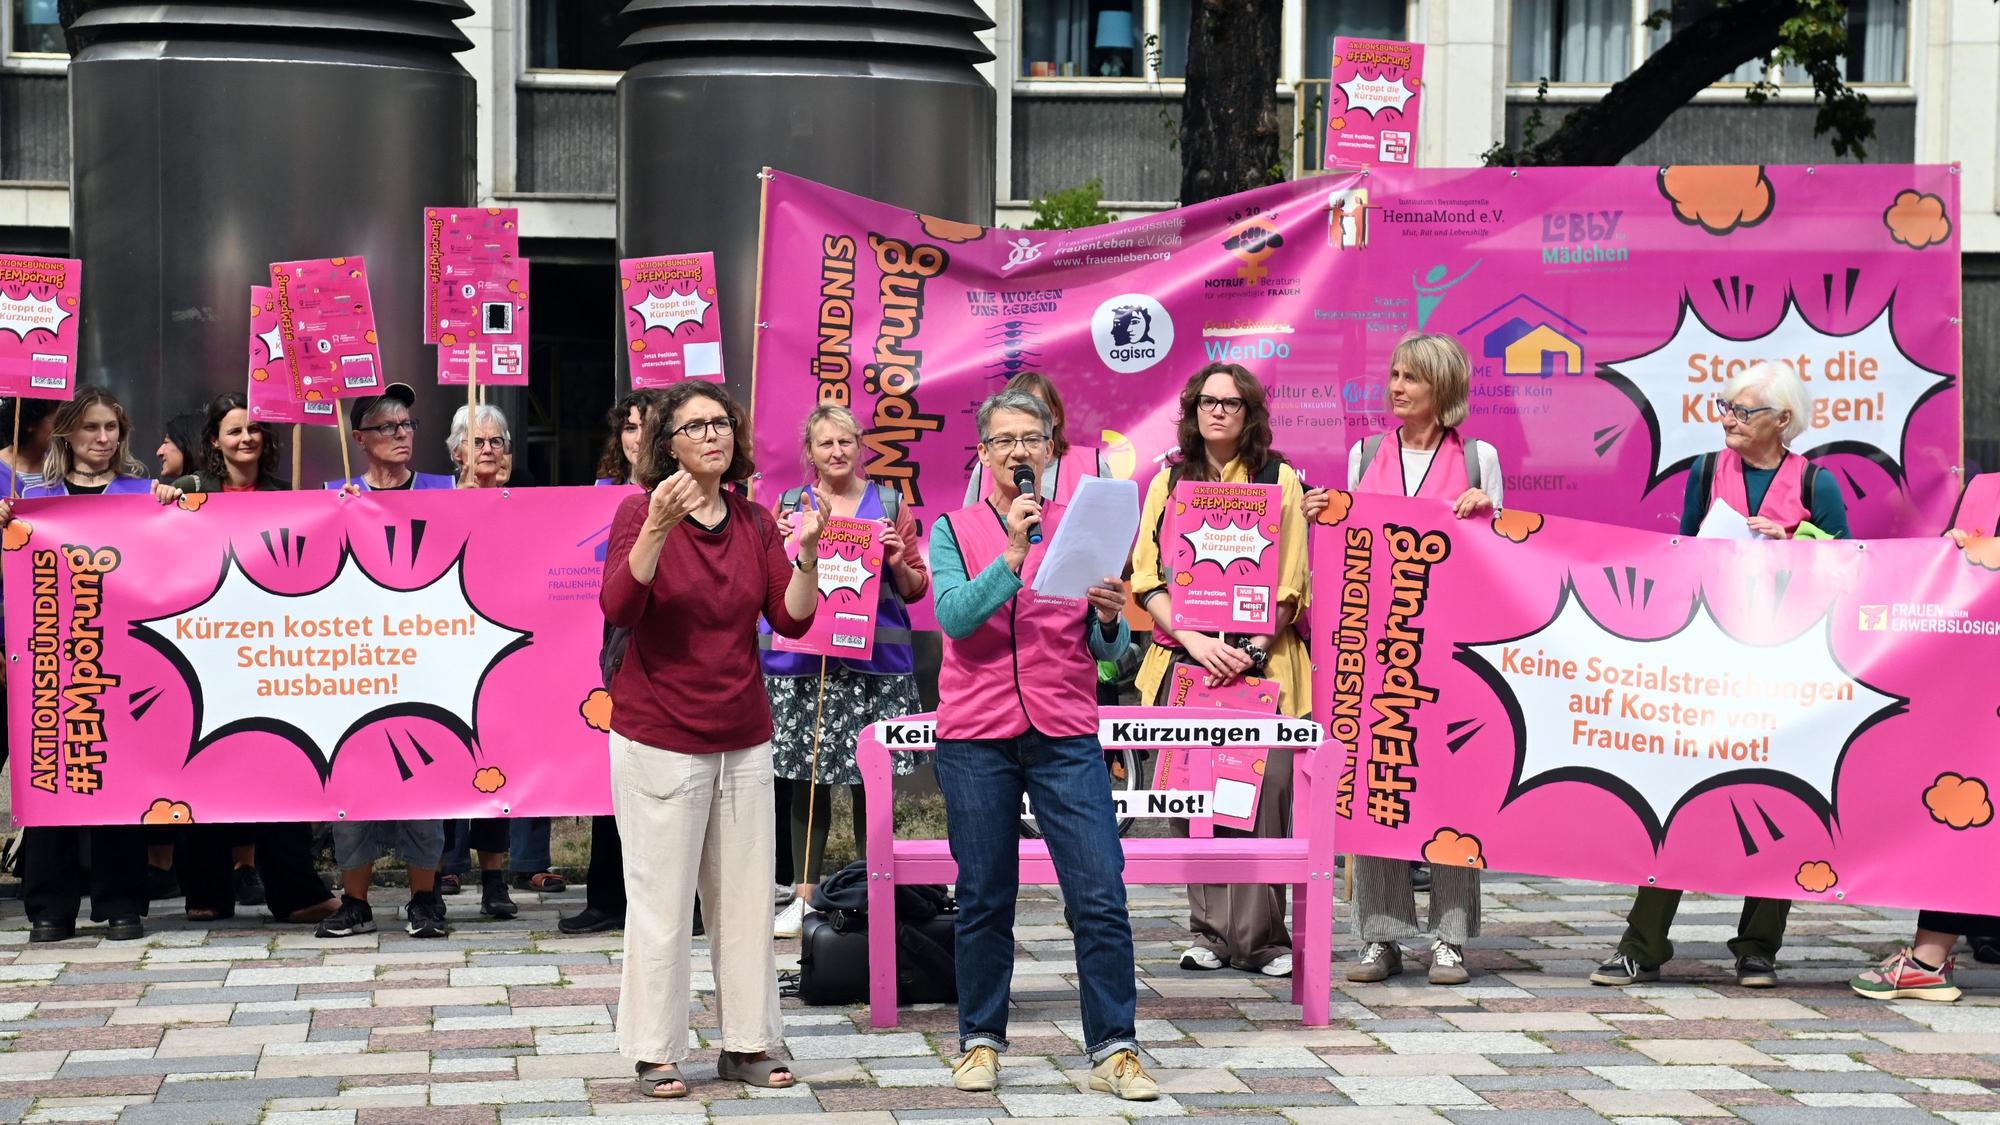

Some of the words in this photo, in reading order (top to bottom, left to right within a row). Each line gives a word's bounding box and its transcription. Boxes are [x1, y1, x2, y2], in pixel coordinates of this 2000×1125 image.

[1347, 51, 1412, 70] #FEMpörung
[1353, 92, 1400, 103] Kürzungen!
[1355, 83, 1385, 93] Stoppt
[1386, 86, 1399, 94] die
[1383, 209, 1475, 223] HennaMond
[1157, 233, 1182, 246] Köln
[1086, 251, 1171, 265] frauenleben.org
[1542, 243, 1629, 264] Mädchen
[0, 269, 66, 289] FEMpörung
[635, 266, 703, 285] #FEMpörung
[1204, 278, 1245, 288] NOTRUF
[1267, 288, 1300, 297] FRAUEN
[1, 302, 34, 313] Stoppt
[37, 305, 53, 314] die
[649, 308, 698, 318] Kürzungen!
[650, 300, 679, 311] Stoppt
[682, 299, 696, 307] die
[0, 312, 54, 323] Kürzungen!
[811, 234, 857, 407] BÜNDNIS
[1110, 346, 1156, 361] agisra
[1204, 338, 1290, 361] WenDo
[1823, 350, 1879, 381] die
[1264, 385, 1306, 398] Kultur
[1311, 385, 1336, 398] e.V.
[1525, 384, 1552, 397] Köln
[1682, 392, 1885, 429] Kügen!
[1194, 486, 1266, 497] AKTIONSBÜNDNIS
[1192, 496, 1267, 516] #FEMpörung
[820, 529, 872, 550] Mpörung
[1204, 532, 1237, 543] Stoppt
[1240, 534, 1255, 542] die
[1201, 542, 1256, 553] Kürzungen!
[548, 566, 601, 577] AUTONOME
[819, 563, 841, 571] oppt
[843, 564, 857, 573] die
[1892, 603, 1944, 617] FRAUEN
[176, 617, 274, 640] Kürzen
[284, 615, 373, 638] kostet
[383, 614, 476, 637] Leben!
[237, 644, 418, 671] Schutzplätze
[28, 549, 60, 794] AKTIONSBÜNDNIS
[60, 543, 122, 796] #FEMpörung
[1367, 522, 1451, 829] #FEMpörung
[1502, 646, 1578, 680] Keine
[1585, 656, 1854, 707] Sozialstreichungen
[256, 673, 398, 697] ausbauen!
[1568, 688, 1614, 716] auf
[1620, 692, 1715, 726] Kosten
[1725, 709, 1776, 730] von
[1112, 722, 1260, 746] Kürzungen
[1277, 723, 1318, 743] bei
[1572, 720, 1665, 754] Frauen
[1674, 729, 1698, 757] in
[1707, 735, 1770, 762] Not!
[1148, 794, 1204, 813] Not!
